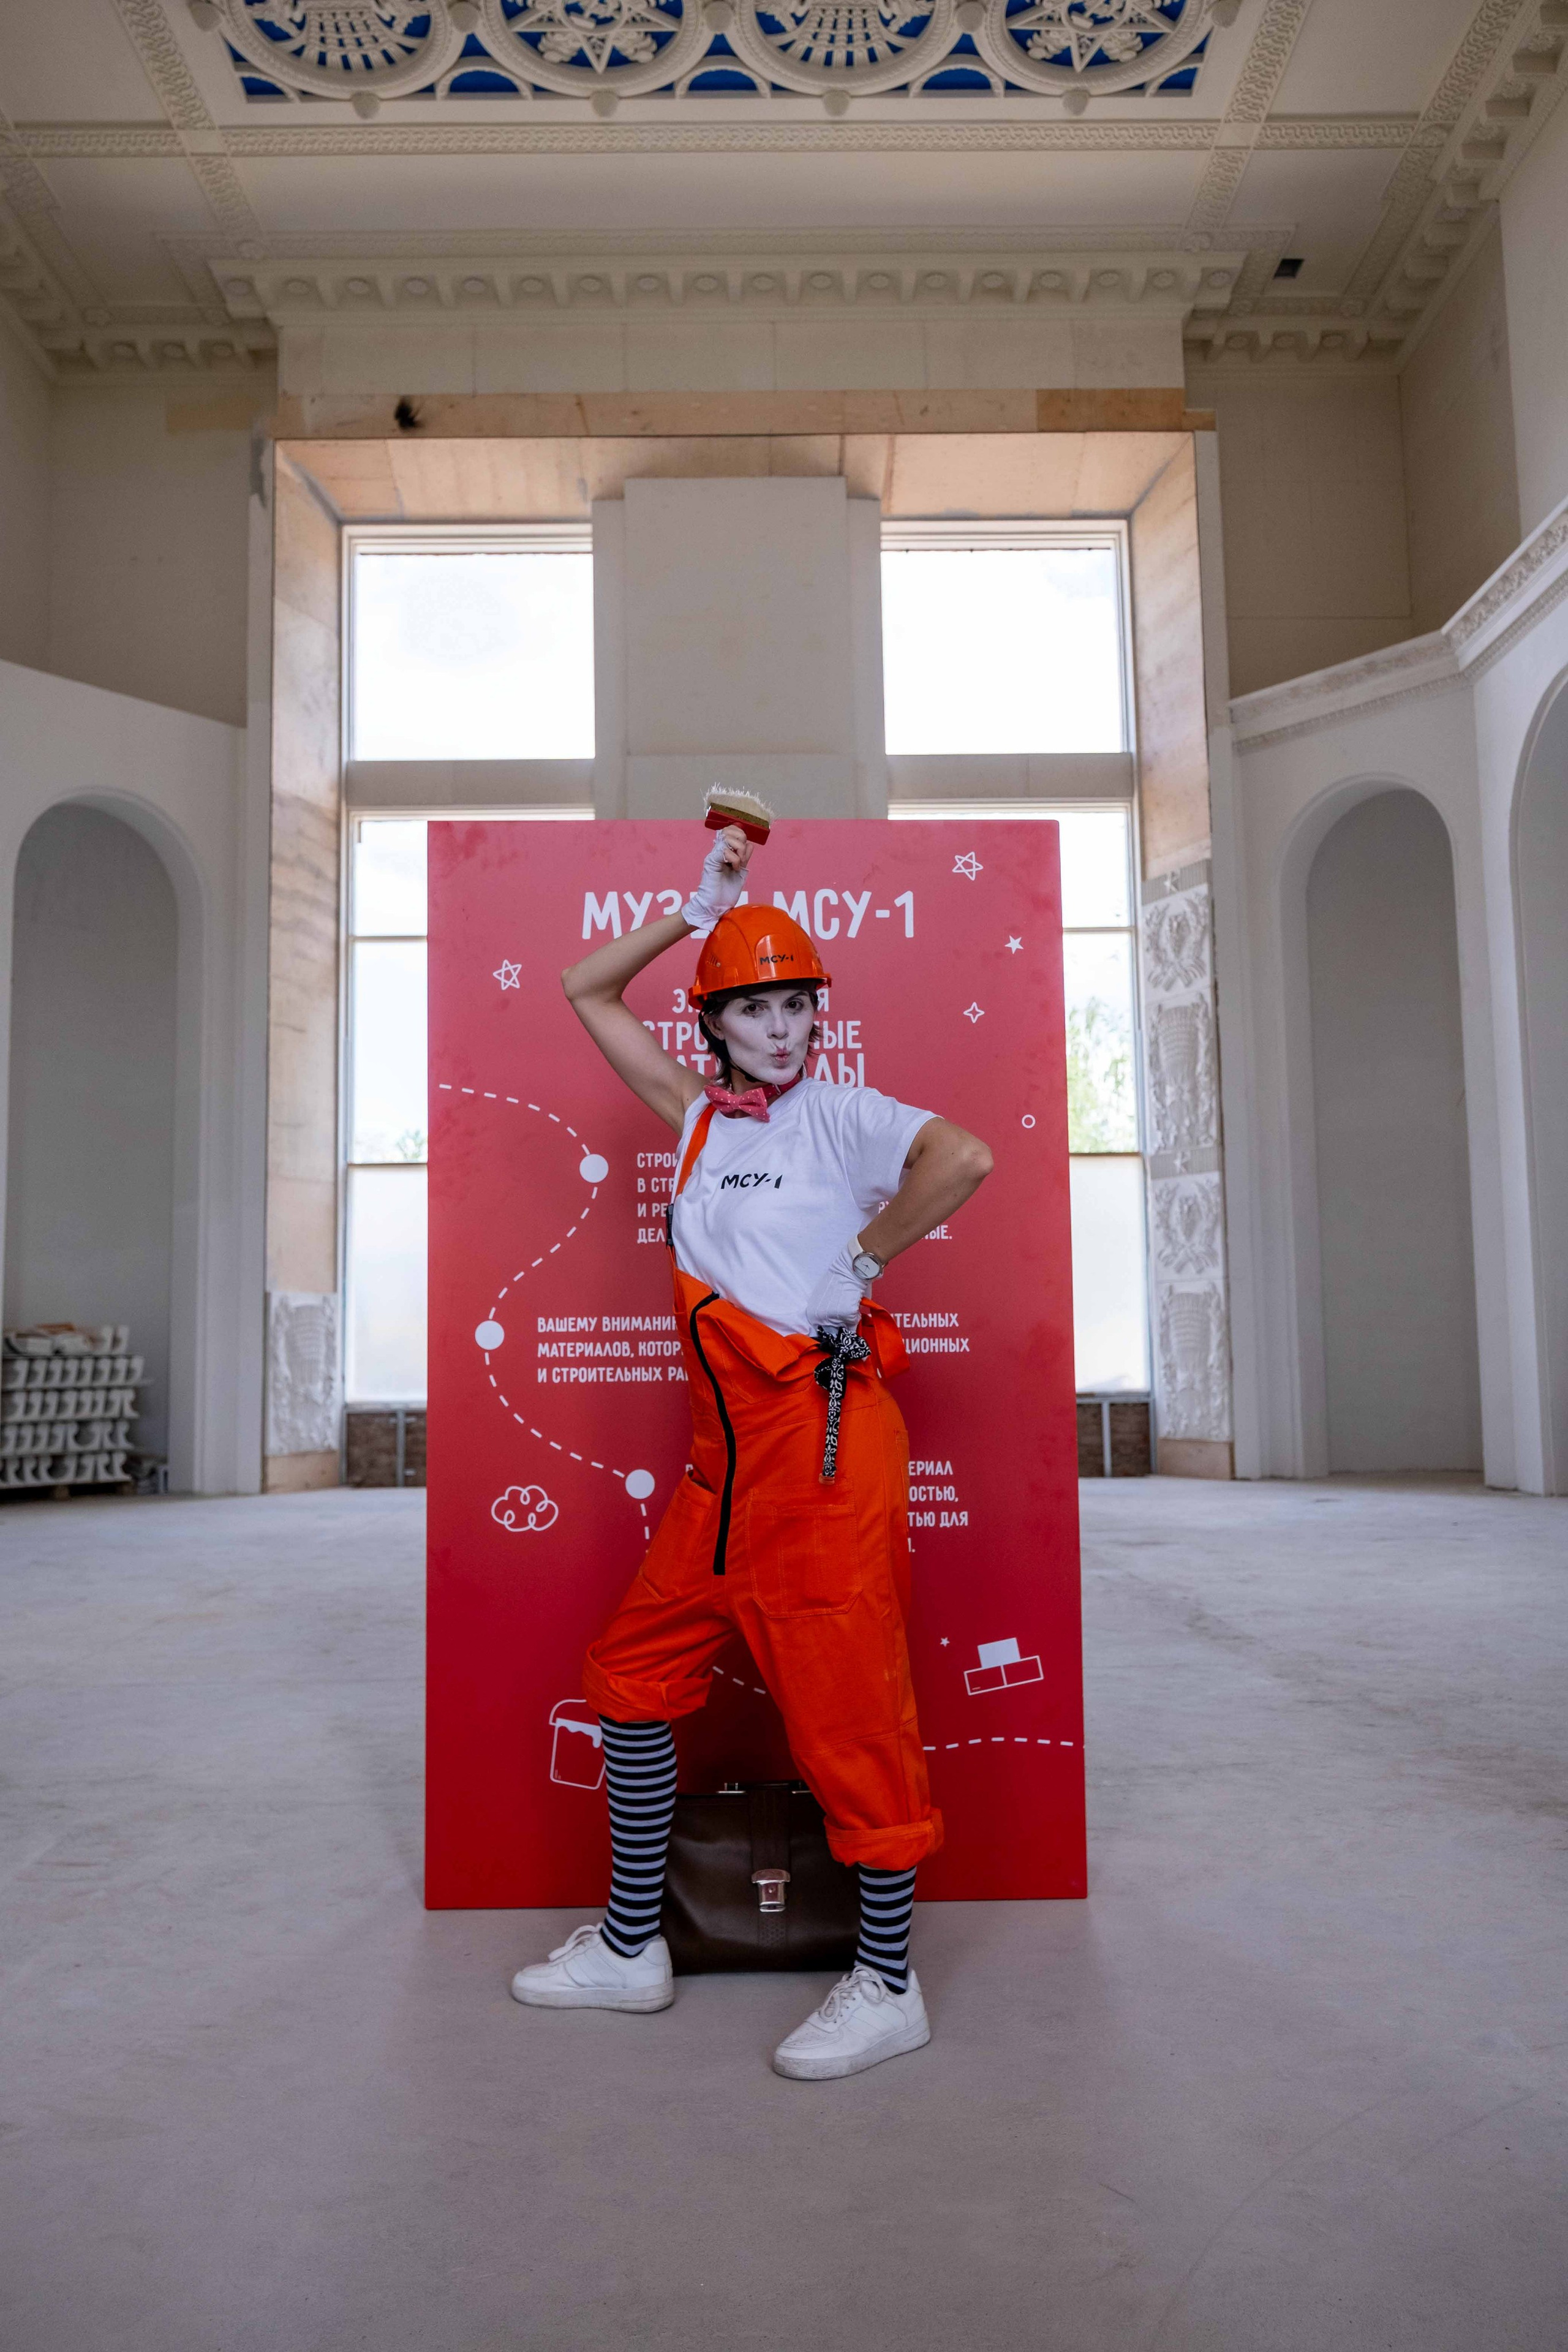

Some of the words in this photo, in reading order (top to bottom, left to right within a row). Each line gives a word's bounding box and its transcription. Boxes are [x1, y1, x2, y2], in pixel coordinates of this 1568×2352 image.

[772, 888, 914, 940] МСУ-1
[760, 954, 794, 965] МСУ-1
[638, 1178, 646, 1193] В
[721, 1173, 783, 1189] МСУ-1
[638, 1203, 647, 1217] И
[637, 1227, 666, 1243] ДЕЛ
[537, 1317, 597, 1333] ВАШЕМУ
[891, 1313, 959, 1328] ТЕЛЬНЫХ
[537, 1341, 635, 1358] МАТЕРИАЛОВ,
[638, 1341, 684, 1356] КОТОР
[902, 1338, 970, 1354] ЦИОННЫХ
[537, 1368, 547, 1383] И
[552, 1366, 663, 1383] СТРОИТЕЛЬНЫХ
[908, 1461, 954, 1476] ЕРИАЛ
[909, 1485, 959, 1502] ОСТЬЮ,
[907, 1511, 936, 1527] ТЬЮ
[939, 1511, 968, 1528] ДЛЯ
